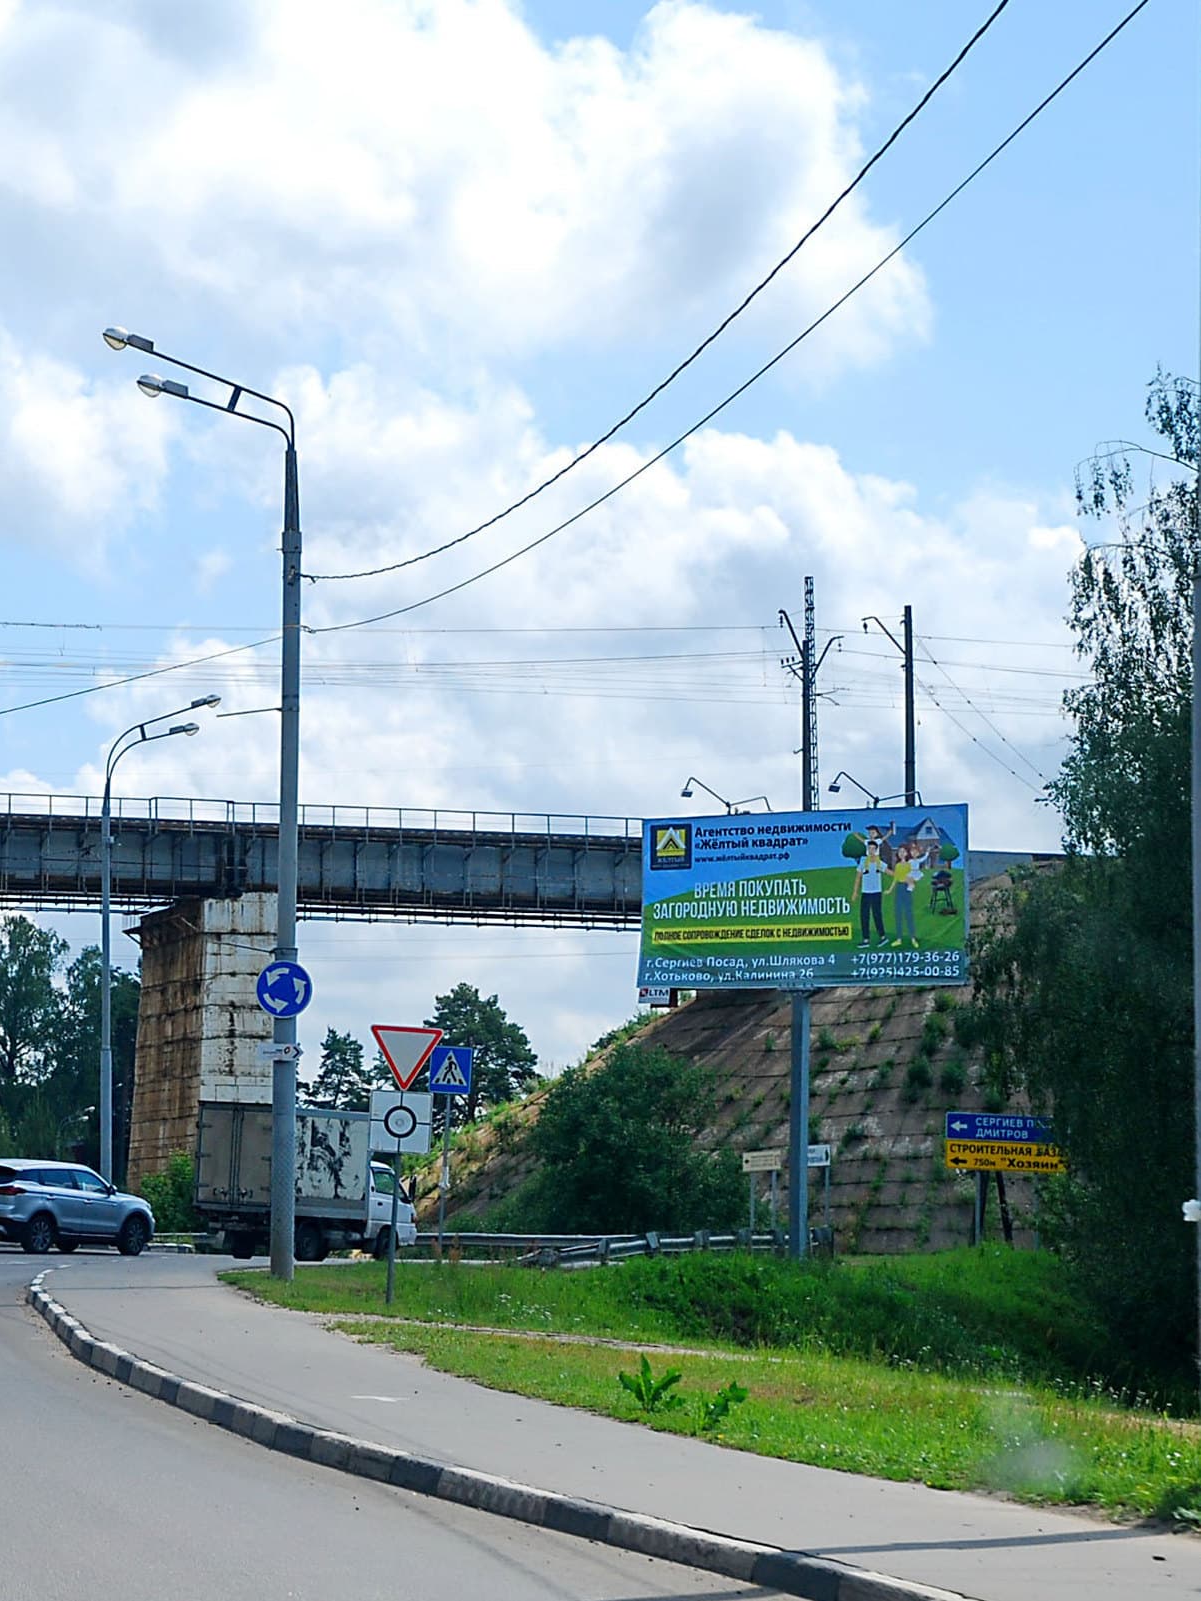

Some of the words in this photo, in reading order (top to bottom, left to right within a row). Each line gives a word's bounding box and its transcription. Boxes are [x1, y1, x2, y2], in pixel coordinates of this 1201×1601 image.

[694, 826, 754, 839] Агентство
[757, 822, 852, 836] недвижимости
[694, 837, 750, 850] «Жёлтый
[751, 836, 809, 849] квадрат»
[694, 880, 736, 899] ВРЕМЯ
[739, 878, 807, 898] ПОКУПАТЬ
[653, 900, 738, 920] ЗАГОРОДНУЮ
[741, 896, 851, 918] НЕДВИЖИМОСТЬ
[654, 930, 682, 941] ПОЛНОЕ
[683, 929, 744, 941] СОПРОВОЖДЕНИЕ
[745, 928, 775, 939] СДЕЛОК
[776, 927, 782, 938] С
[782, 926, 849, 938] НЕДВИЖИМОСТЬЮ
[706, 956, 749, 969] Посад,
[751, 954, 825, 967] ул.Шлякова
[827, 954, 836, 966] 4
[850, 951, 960, 965] +7(977)179-36-26
[644, 970, 715, 982] г.Хотьково,
[717, 969, 796, 983] ул.Калинина
[850, 965, 960, 979] +7(925)425-00-85
[649, 989, 669, 997] LTM
[975, 1117, 1024, 1128] СЕРГИЕВ
[975, 1128, 1029, 1139] ДМИТРОВ
[949, 1143, 1033, 1157] СТРОИТЕЛЬНАЯ
